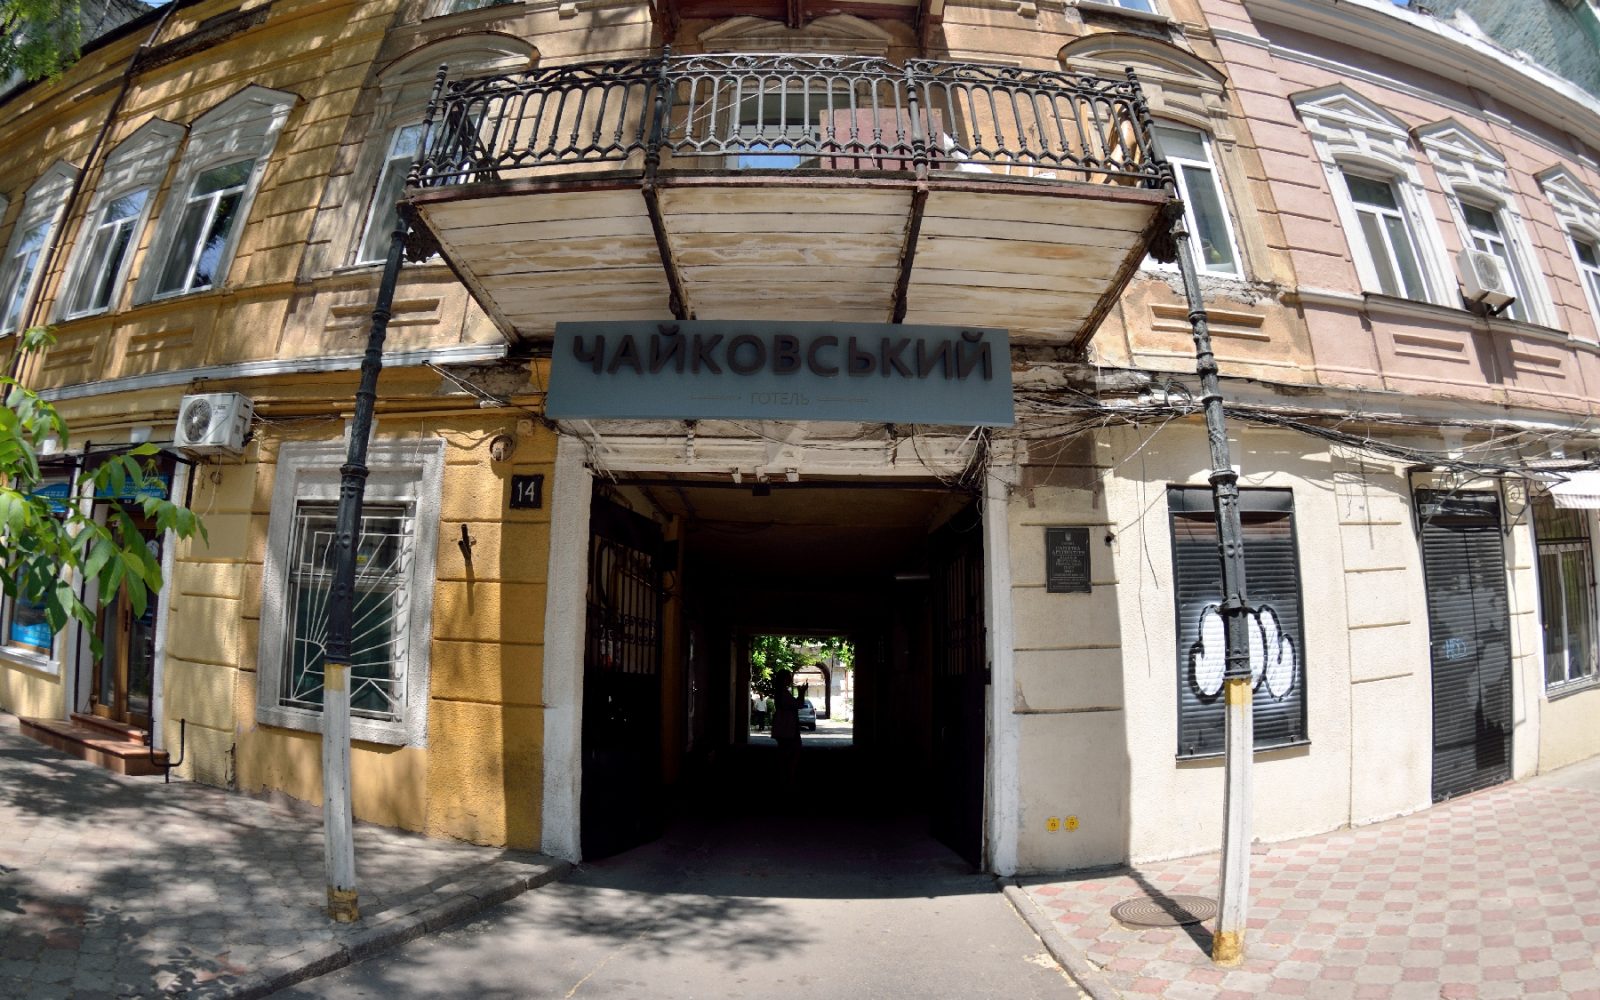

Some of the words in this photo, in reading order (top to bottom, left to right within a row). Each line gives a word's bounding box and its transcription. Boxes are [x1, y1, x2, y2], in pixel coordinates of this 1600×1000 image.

[572, 324, 993, 381] ЧАЙКОВСЬКИЙ
[751, 391, 810, 406] ГОТЕЛЬ
[517, 481, 536, 503] 14
